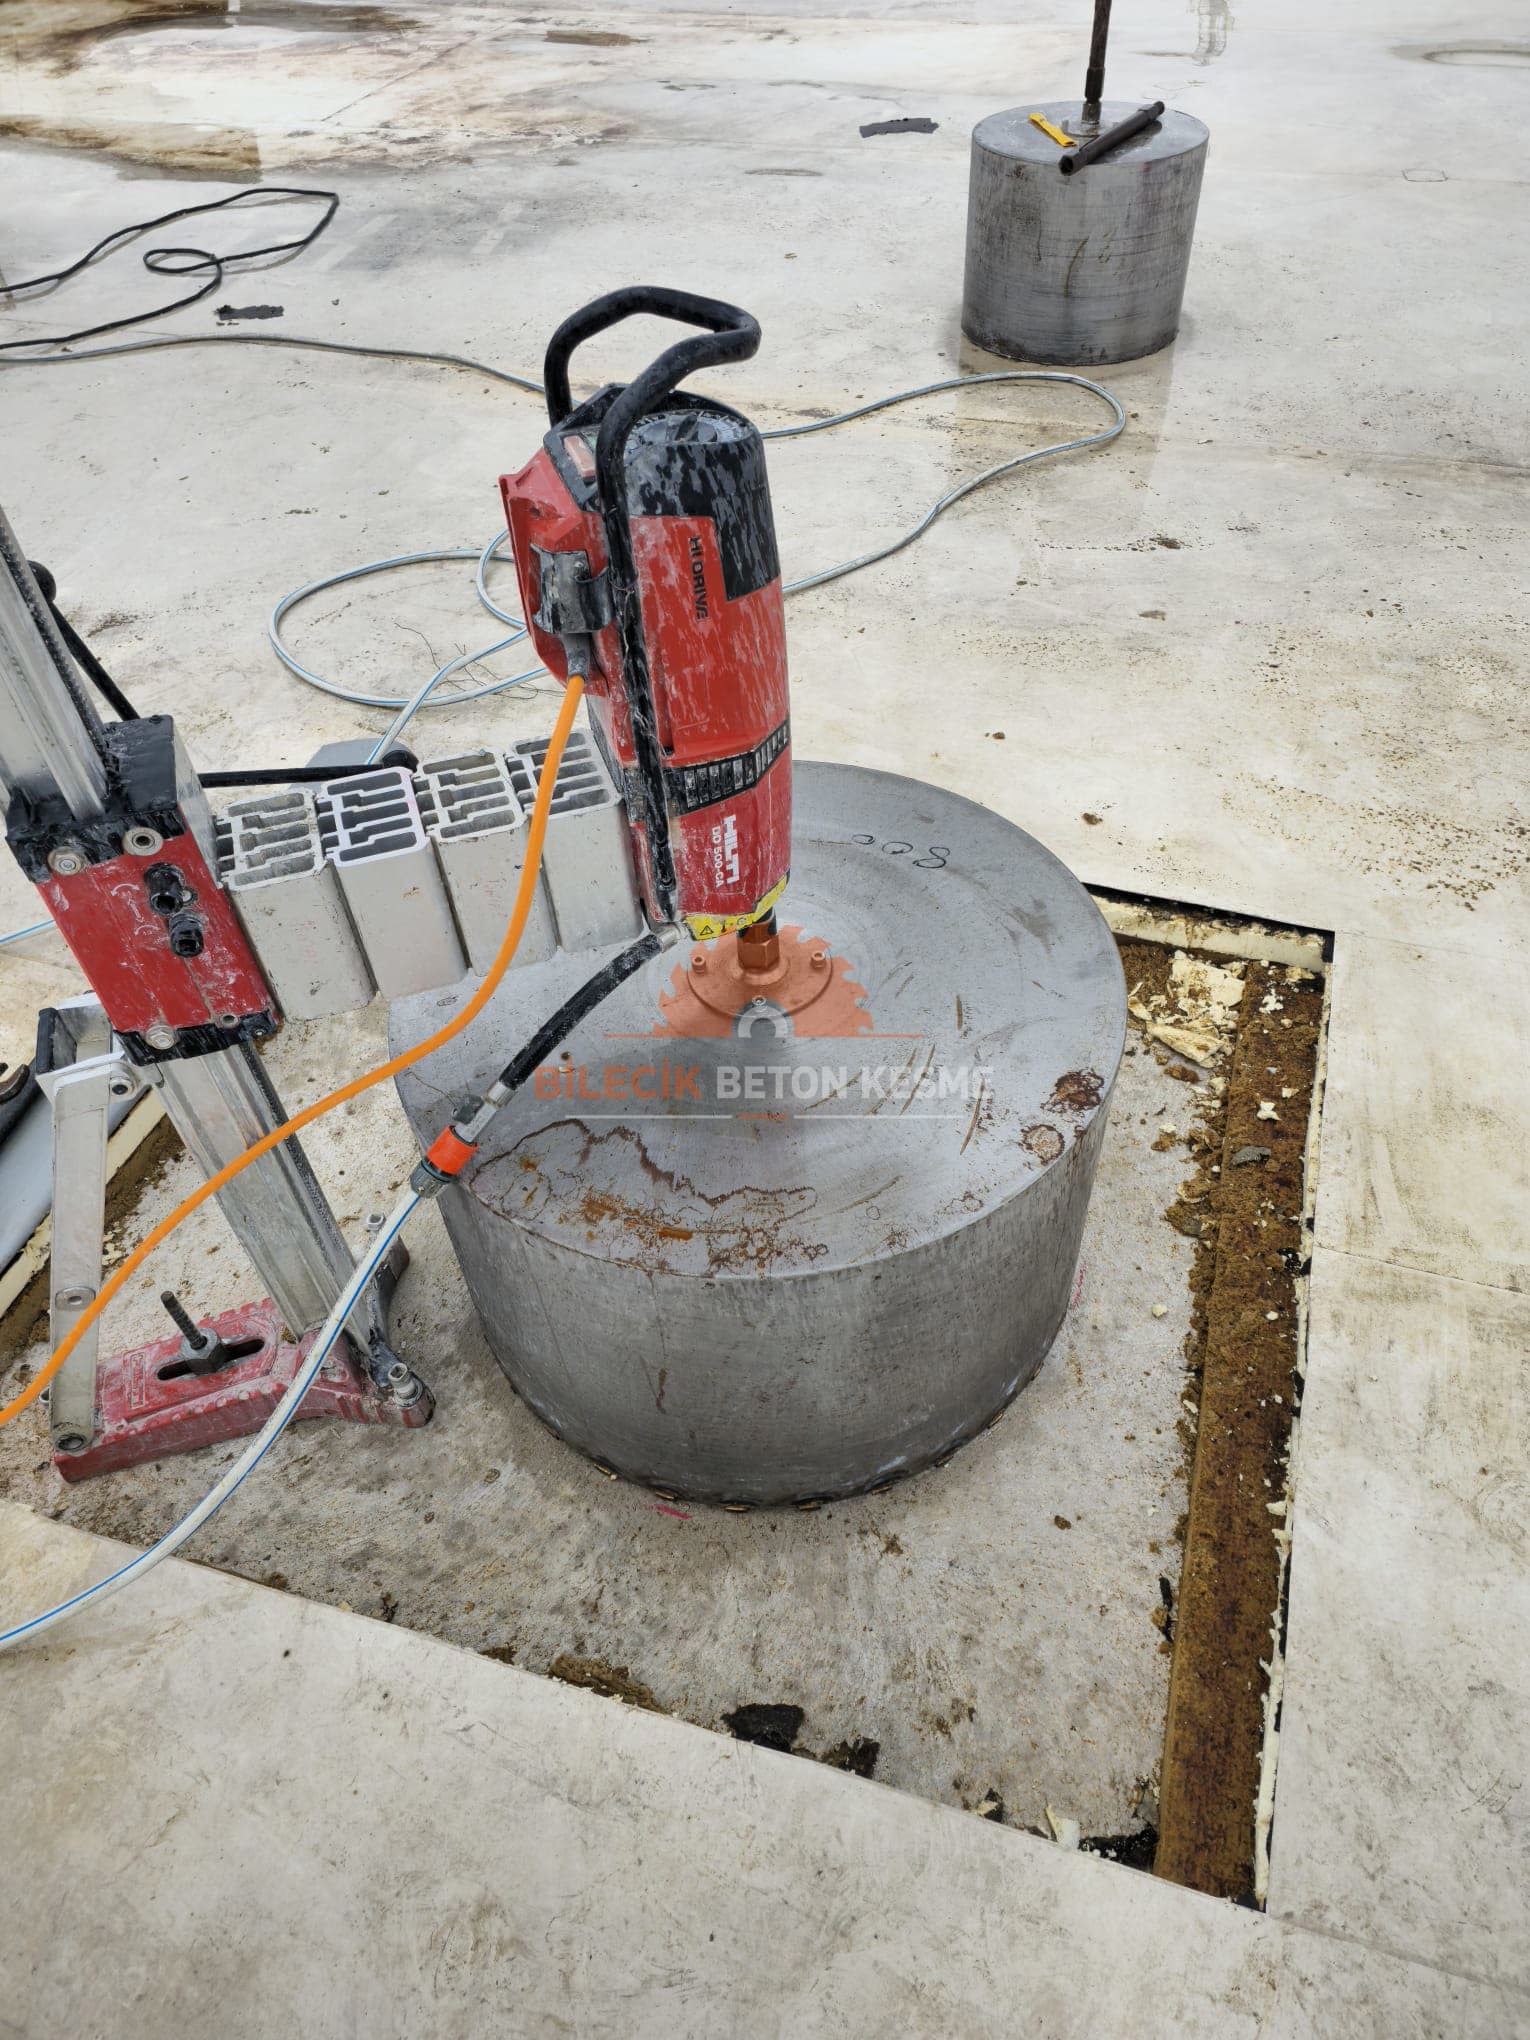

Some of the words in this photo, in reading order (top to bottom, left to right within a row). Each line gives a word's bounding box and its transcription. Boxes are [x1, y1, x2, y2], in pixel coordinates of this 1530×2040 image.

[712, 826, 721, 844] DD
[724, 814, 739, 884] HILTI
[714, 846, 724, 888] 500-CA
